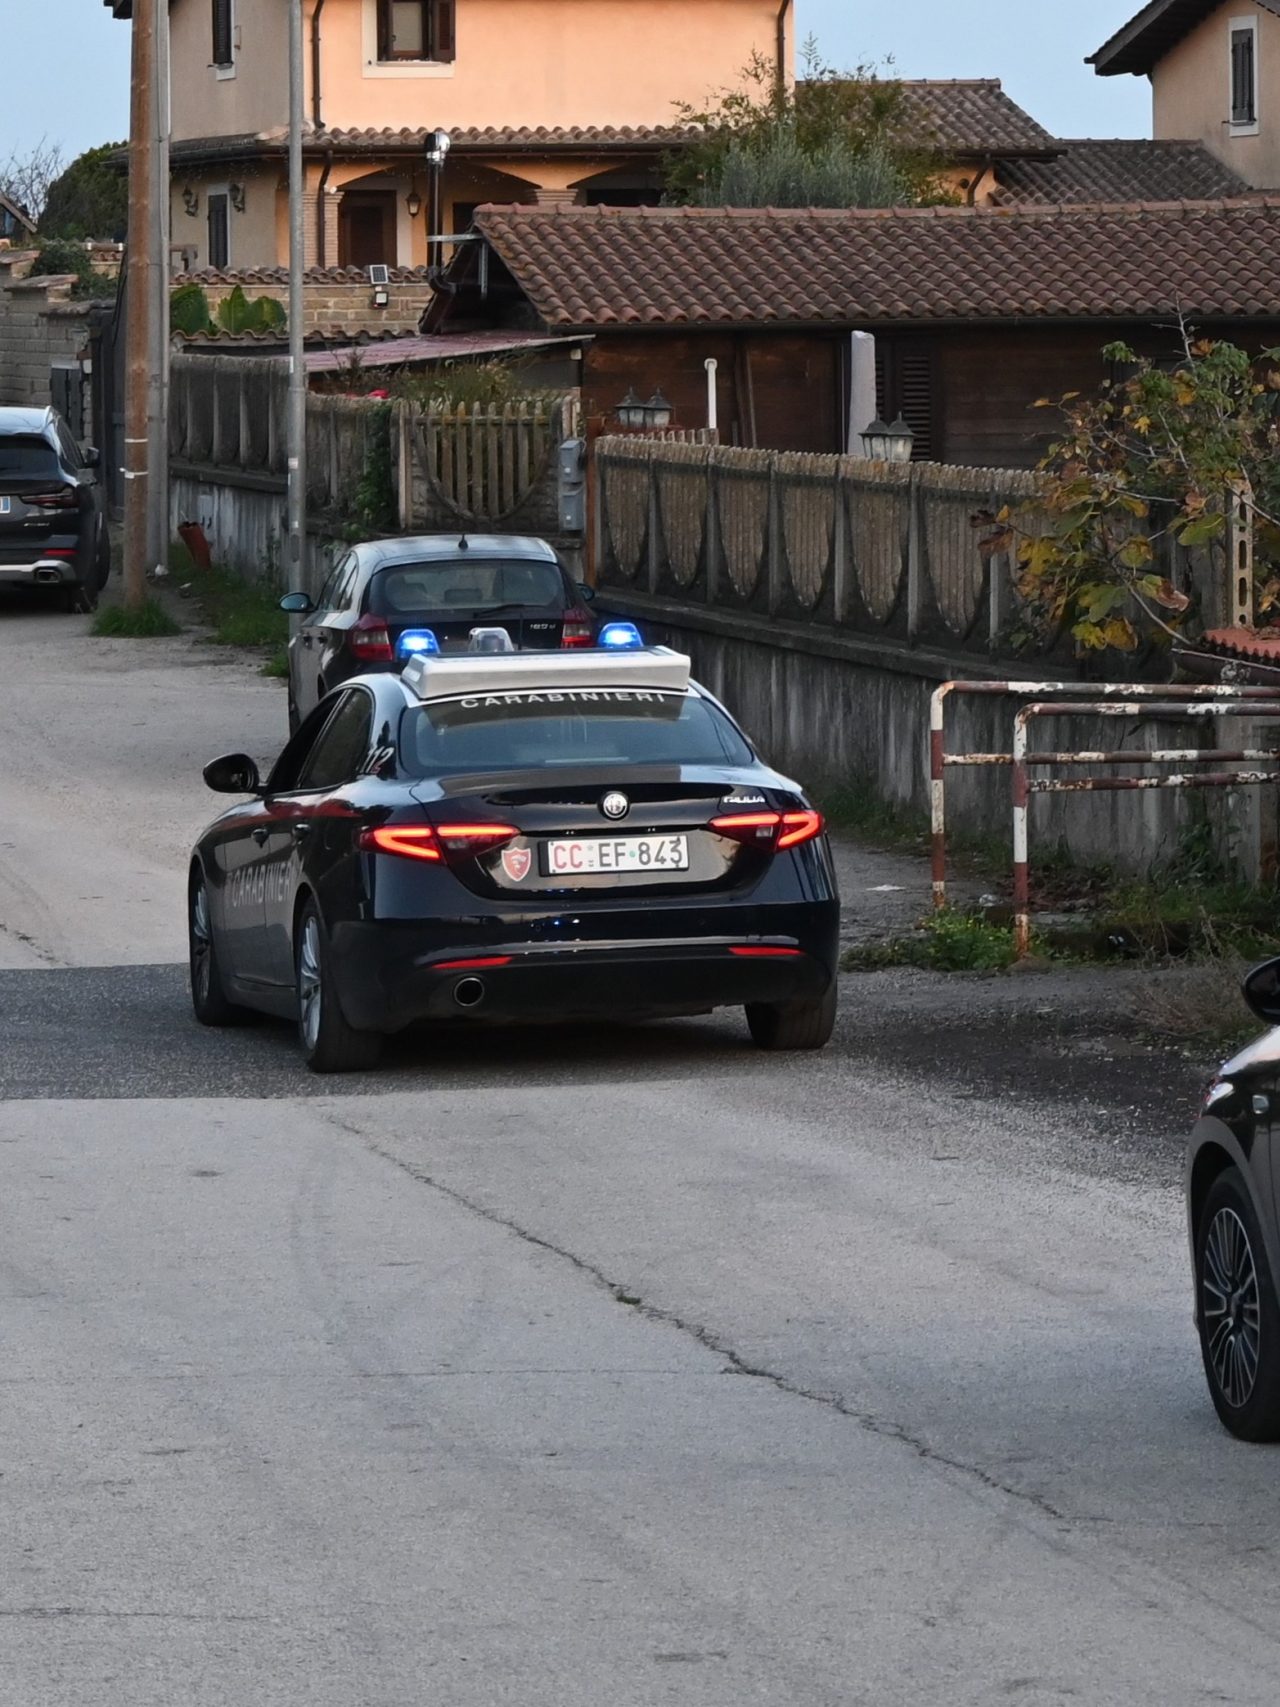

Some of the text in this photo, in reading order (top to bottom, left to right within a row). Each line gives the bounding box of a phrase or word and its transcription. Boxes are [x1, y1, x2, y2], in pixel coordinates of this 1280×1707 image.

[461, 692, 665, 708] CARABINIERI
[554, 839, 682, 870] CC EF 843
